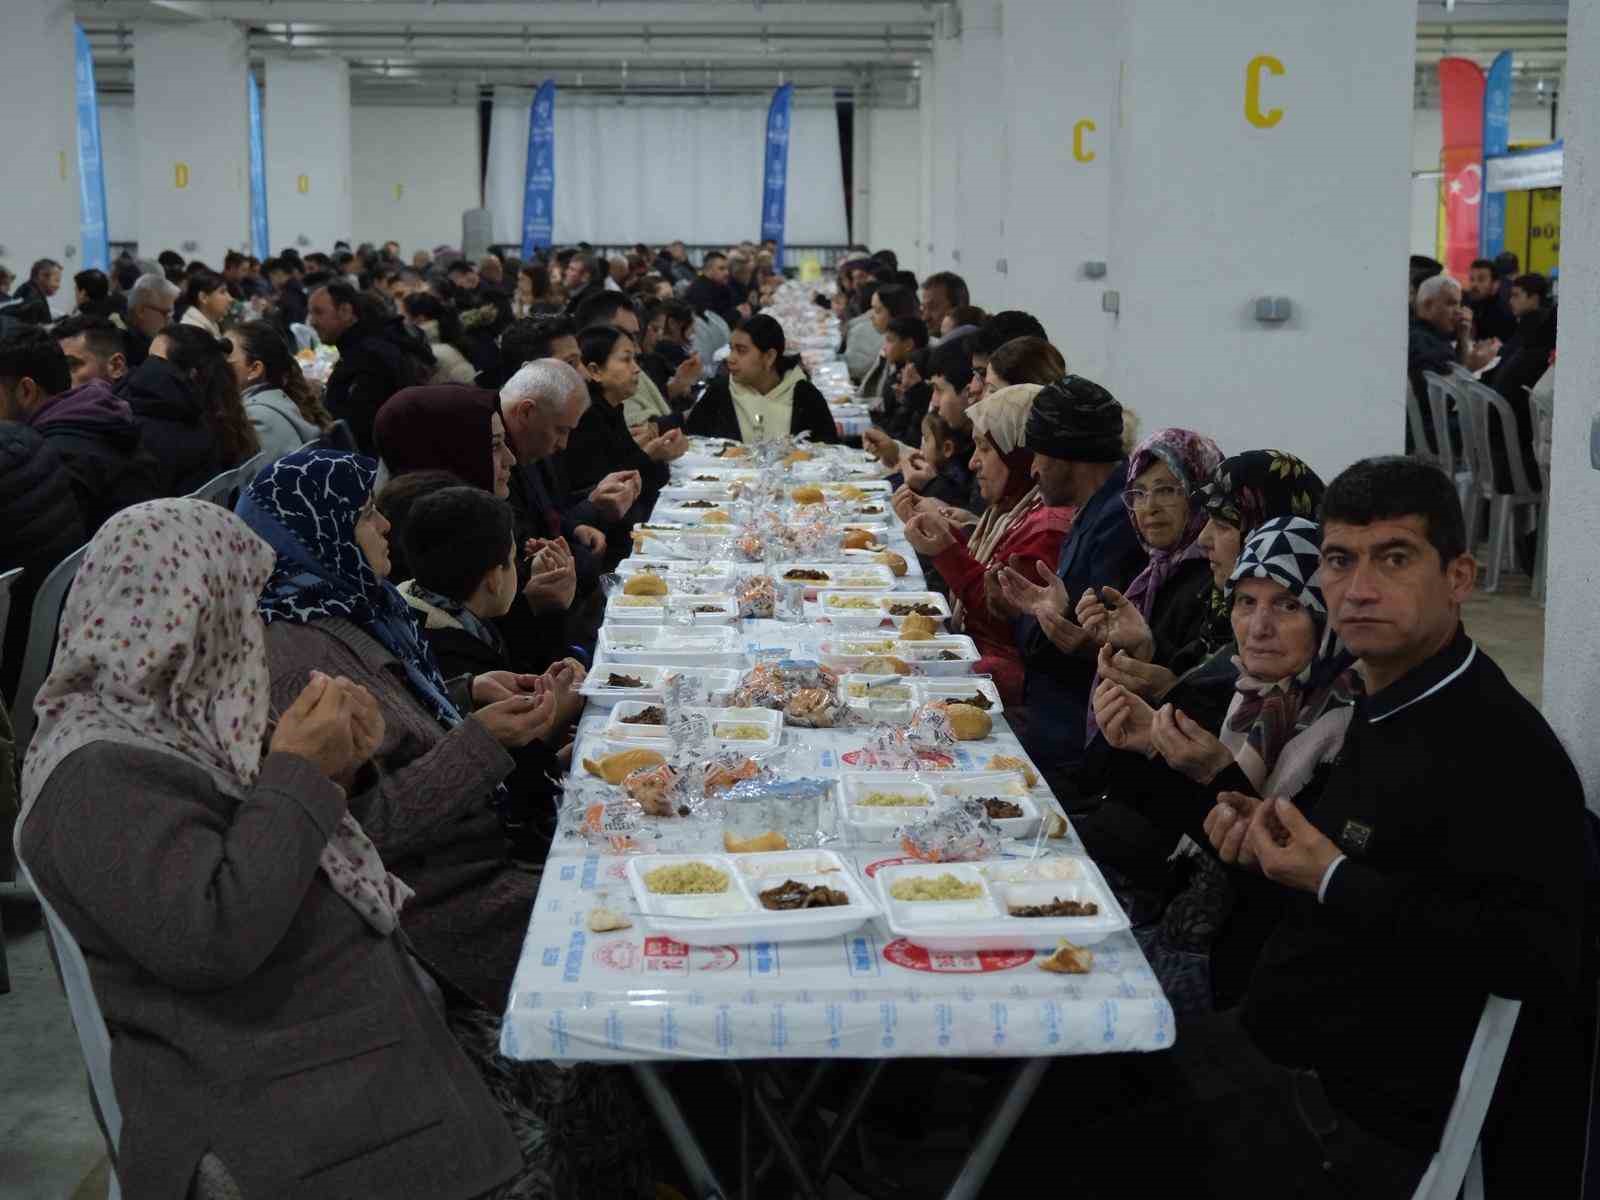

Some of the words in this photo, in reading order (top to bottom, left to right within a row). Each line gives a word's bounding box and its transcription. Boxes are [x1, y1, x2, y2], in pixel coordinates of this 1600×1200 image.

[1244, 54, 1286, 128] C
[1073, 119, 1096, 163] C
[174, 162, 189, 188] D
